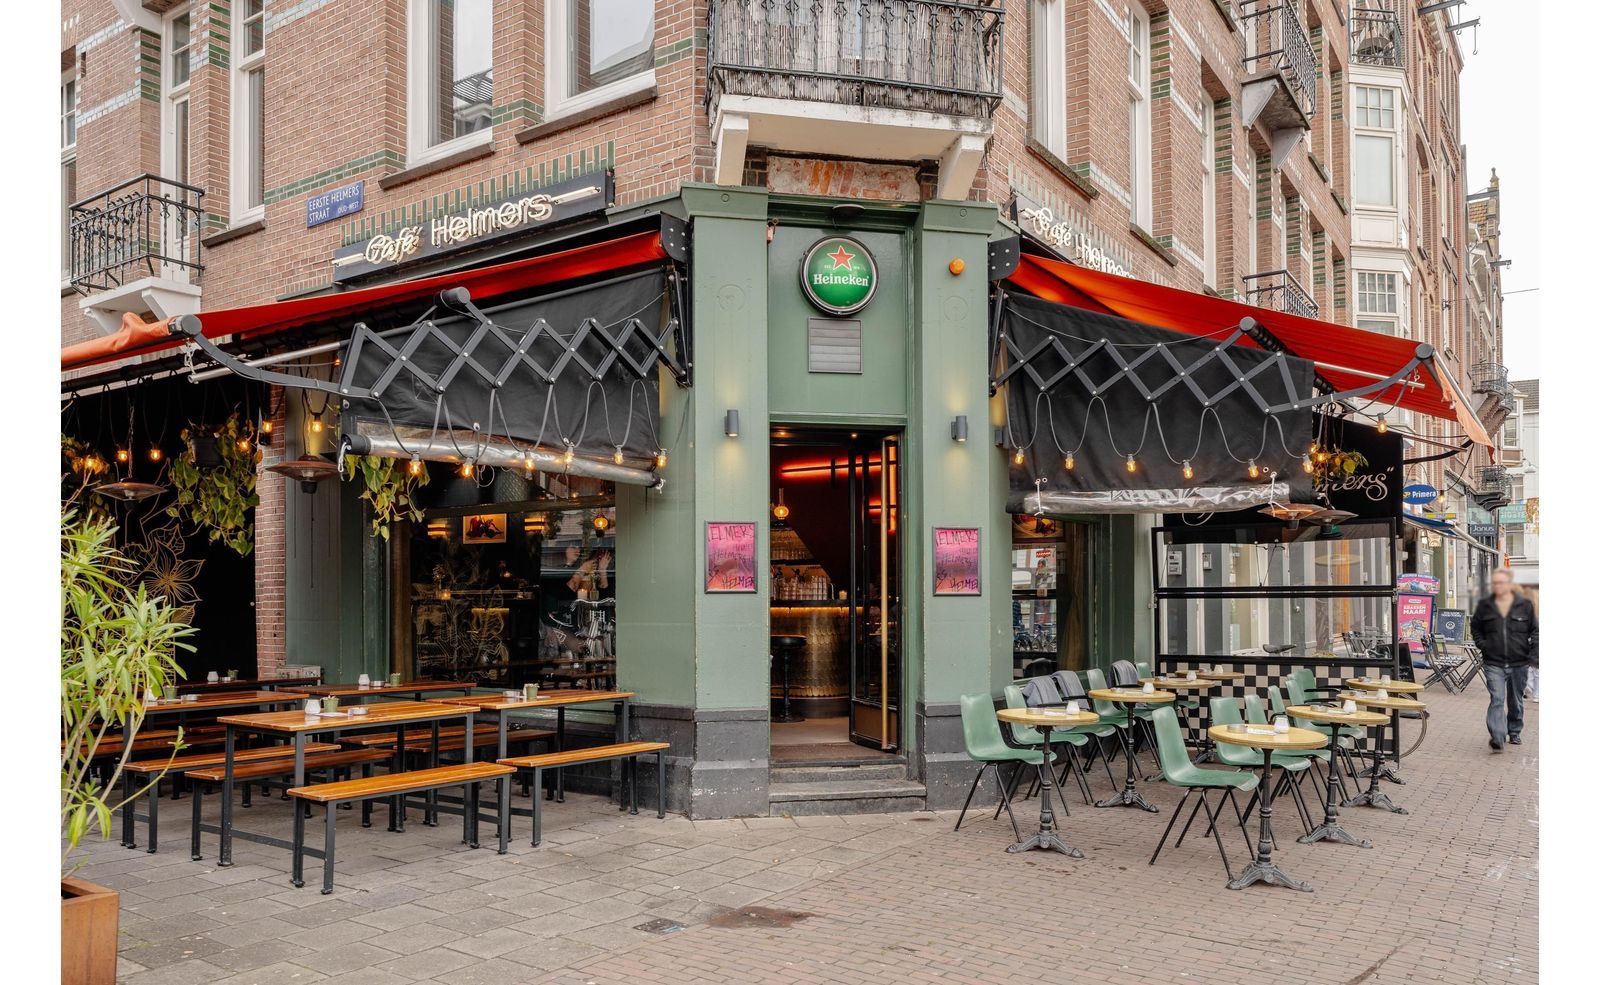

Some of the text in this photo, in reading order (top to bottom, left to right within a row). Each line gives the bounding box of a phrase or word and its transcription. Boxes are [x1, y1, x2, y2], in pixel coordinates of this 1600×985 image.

[309, 185, 360, 211] EERSTE HELMERS
[309, 207, 330, 223] STRAAT
[337, 201, 360, 214] OUD-WEST
[366, 194, 553, 264] Café Helmers
[813, 273, 869, 287] Heineken
[1412, 490, 1437, 499] Primera
